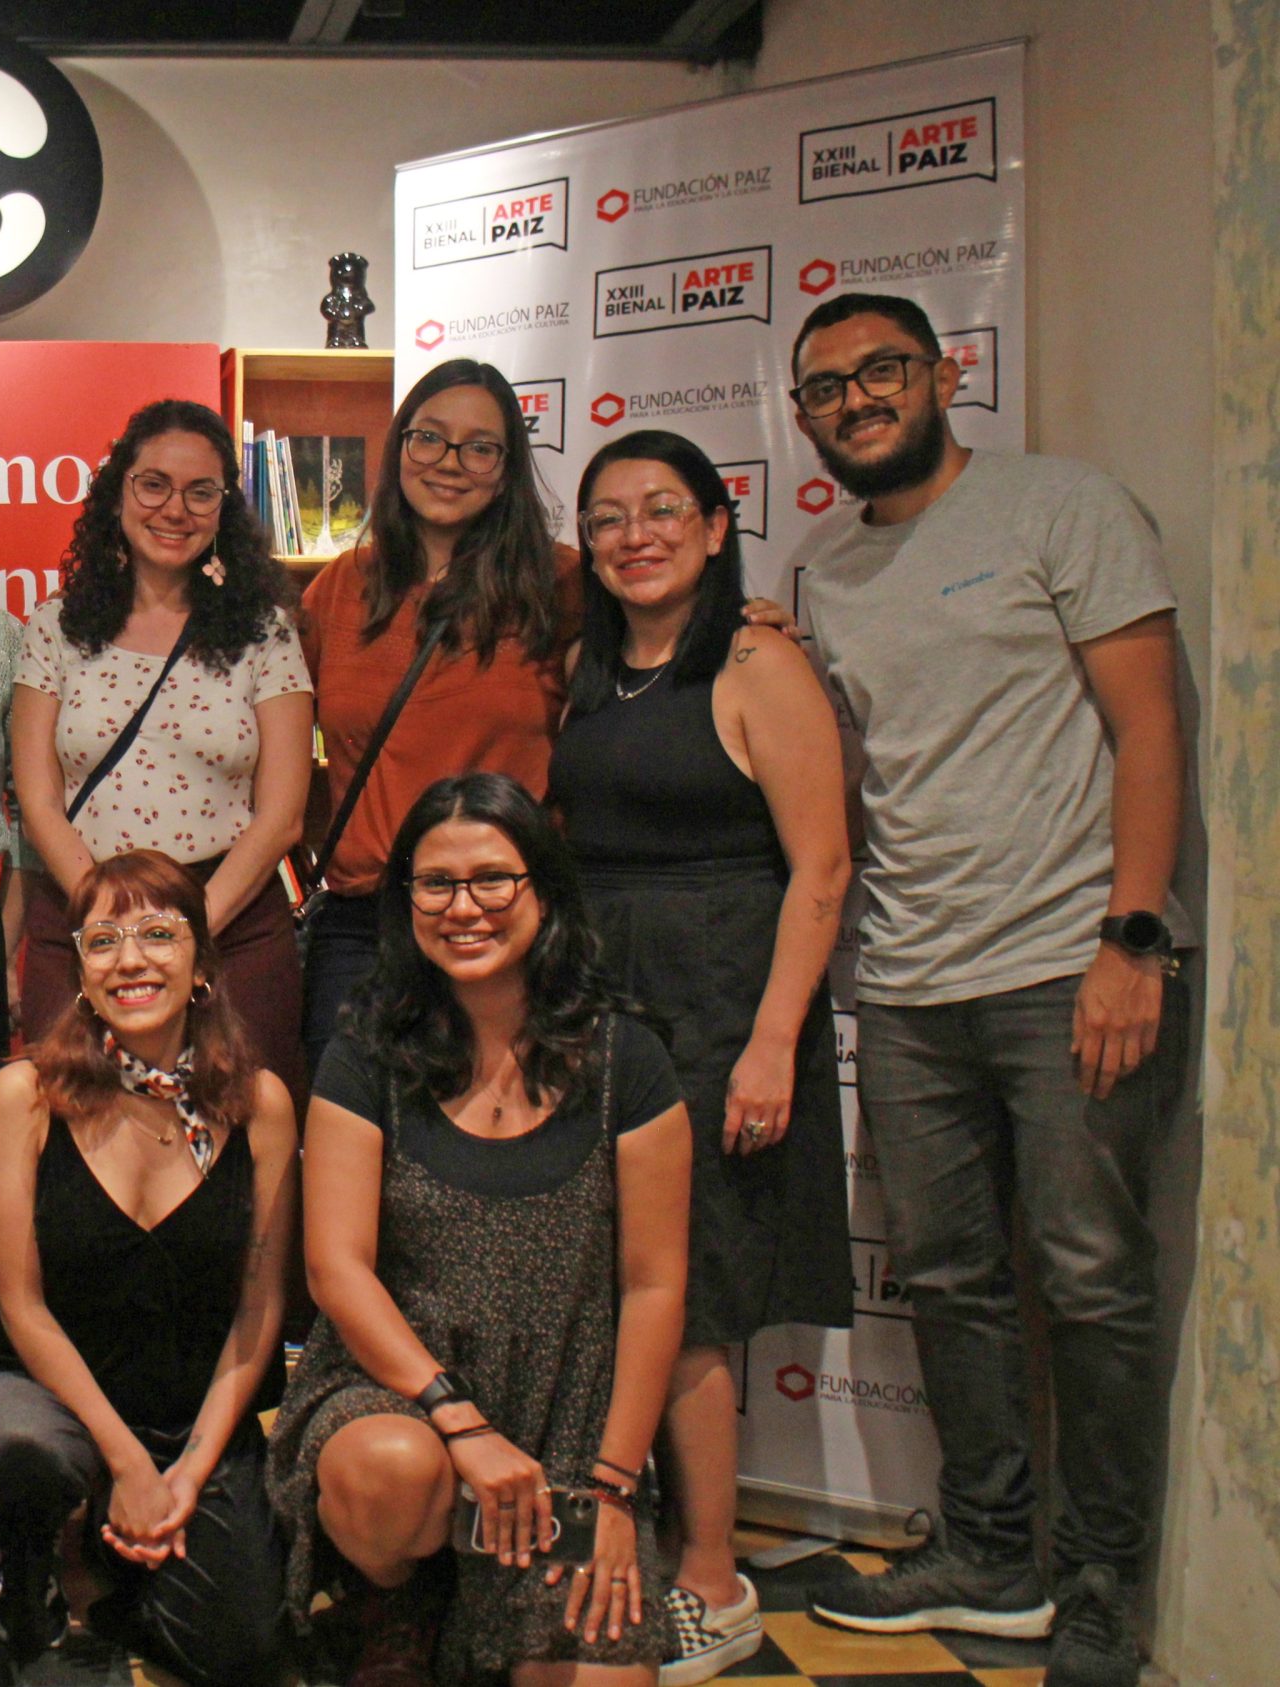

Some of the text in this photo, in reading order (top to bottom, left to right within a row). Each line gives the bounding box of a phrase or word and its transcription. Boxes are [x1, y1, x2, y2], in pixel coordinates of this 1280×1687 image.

[899, 116, 978, 150] ARTE
[813, 145, 856, 164] XXIII
[899, 142, 968, 174] PAIZ
[812, 158, 881, 181] BIENAL
[633, 166, 772, 205] FUNDACIÓN PAIZ
[492, 193, 553, 222] ARTE
[424, 230, 477, 249] BIENAL
[425, 219, 457, 234] XXIII
[492, 216, 544, 243] PAIZ
[840, 246, 949, 277] FUNDACIÓN
[957, 240, 998, 262] PAIZ
[683, 261, 754, 291] ARTE
[605, 297, 666, 317] BIENAL
[606, 284, 644, 302] XXIII
[681, 286, 744, 313] PAIZ
[449, 302, 570, 335] FUNDACIÓN PAIZ
[517, 393, 549, 413] TE
[630, 380, 769, 410] FUNDACIÓN PAIZ
[820, 1374, 930, 1407] FUNDACIÓN
